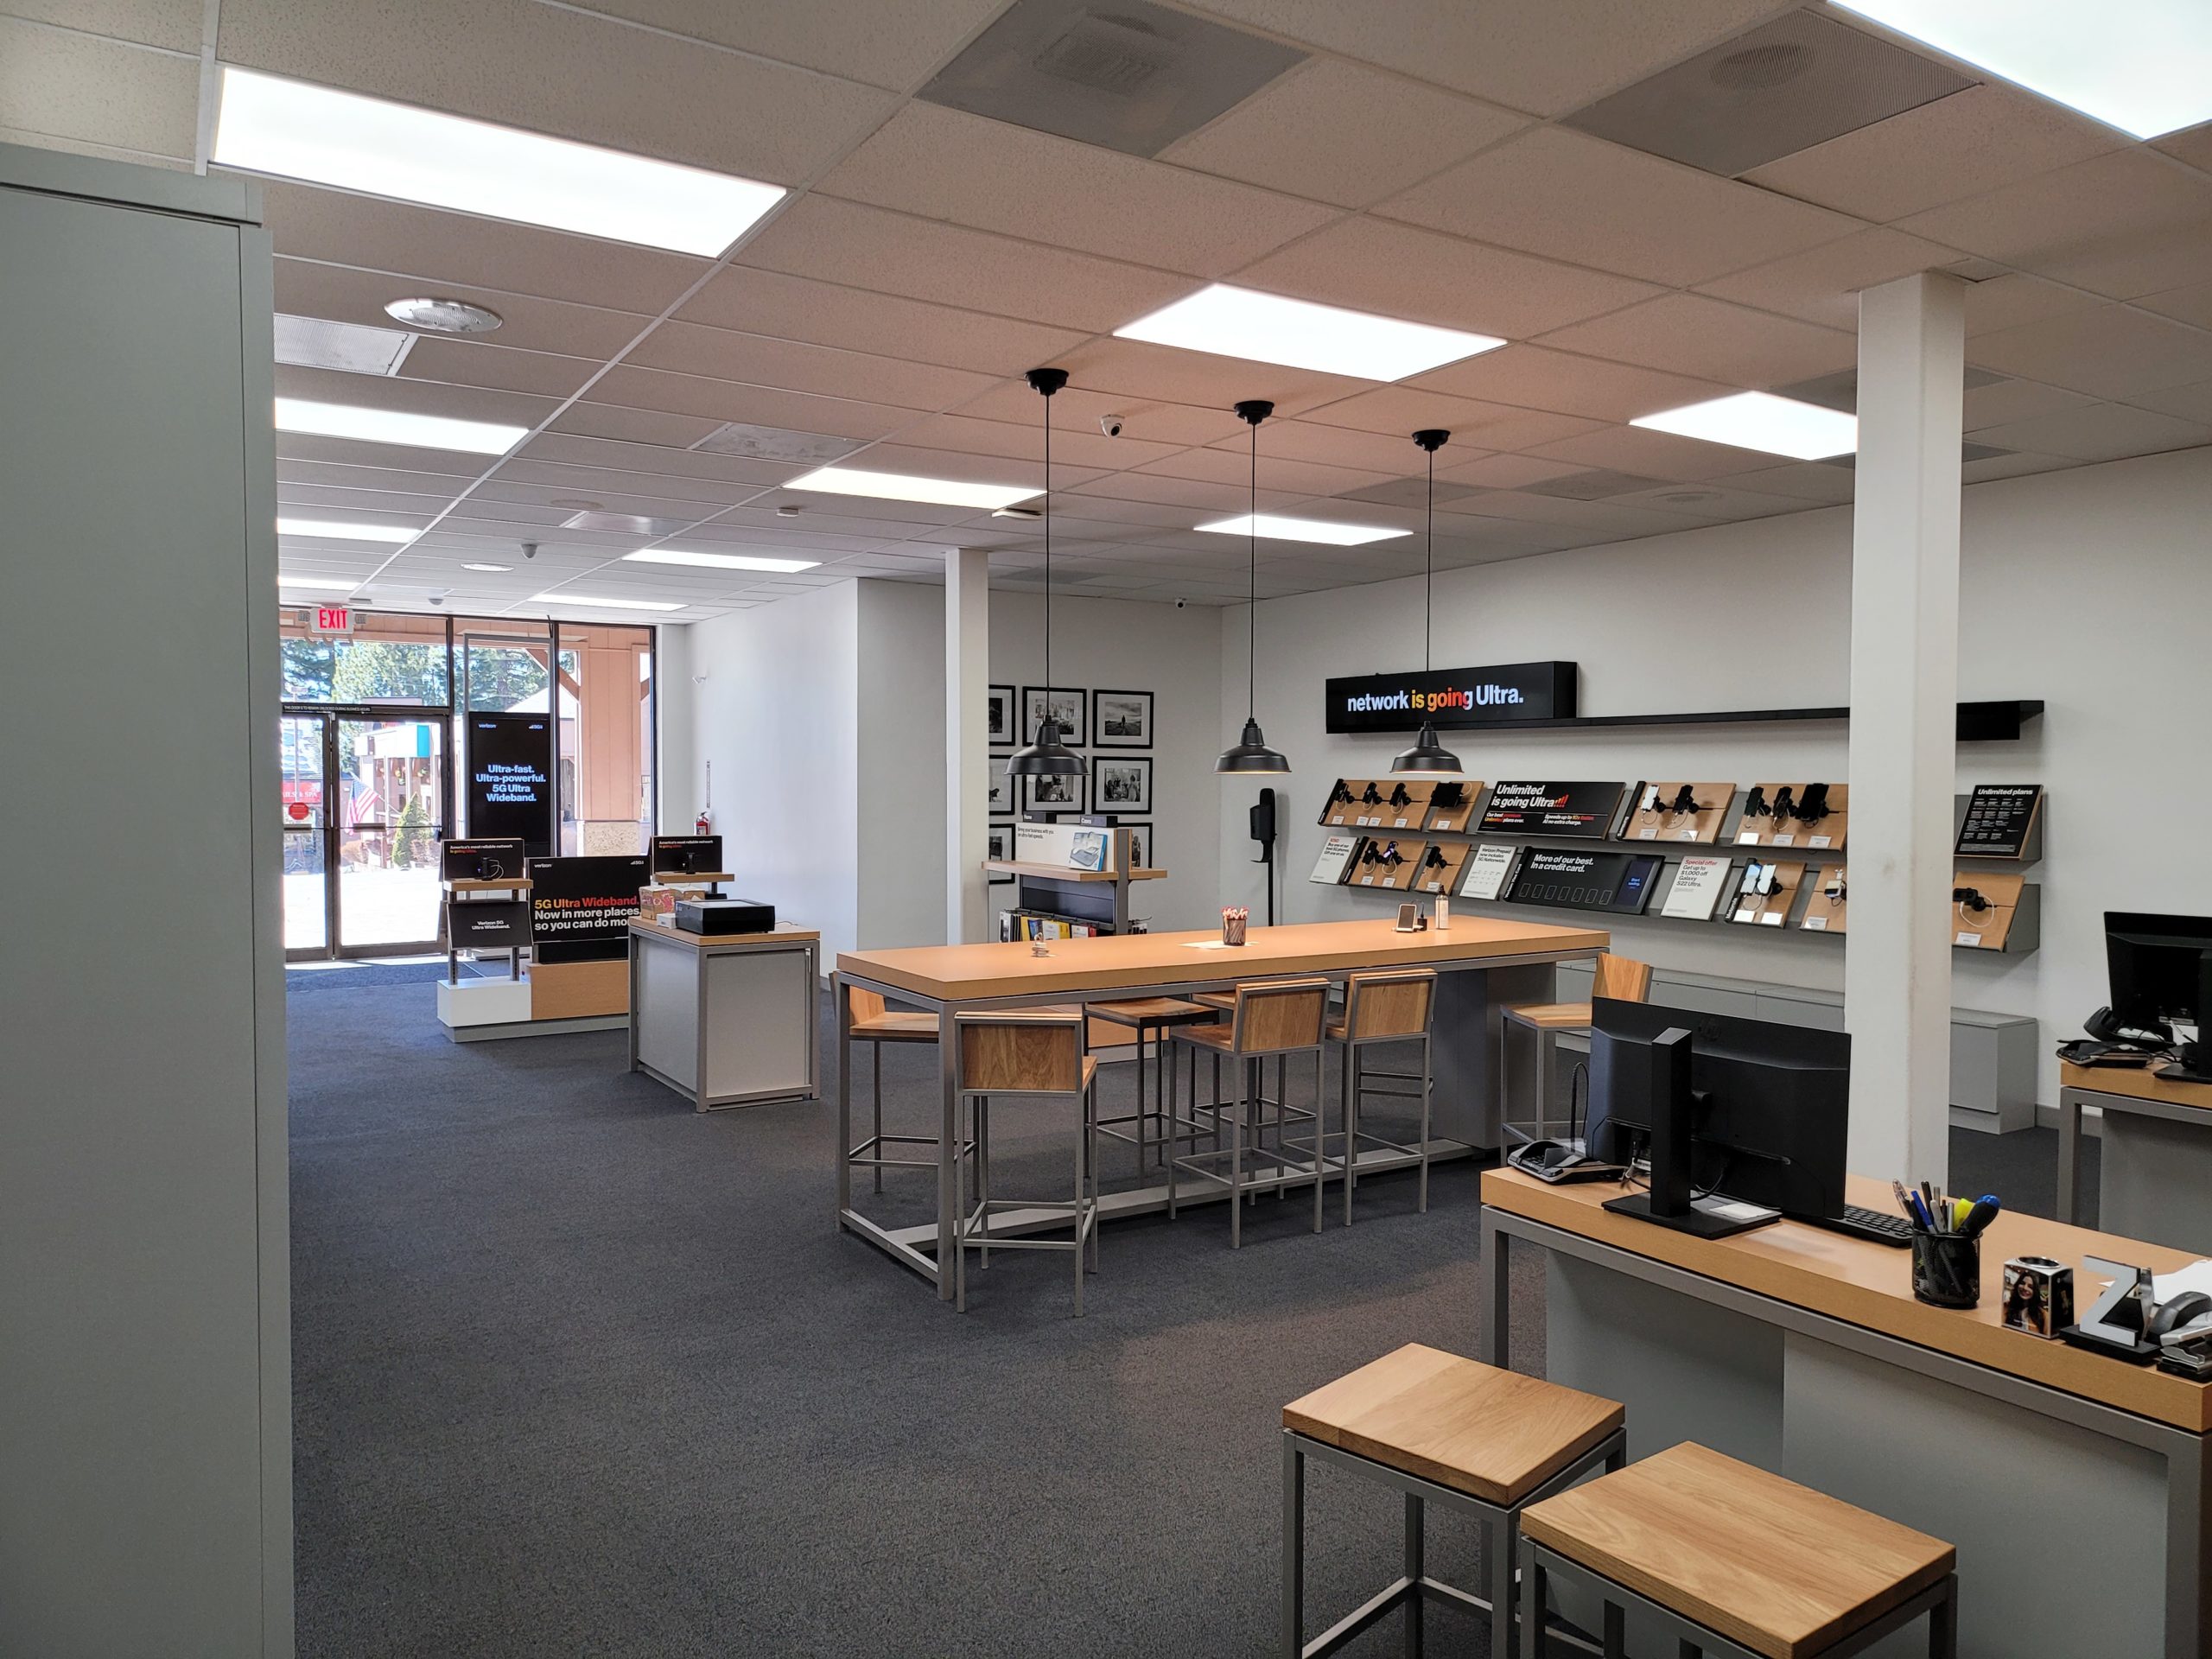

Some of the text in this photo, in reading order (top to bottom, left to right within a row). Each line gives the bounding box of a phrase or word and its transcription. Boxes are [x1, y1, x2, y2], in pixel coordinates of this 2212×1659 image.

[319, 609, 347, 630] EXIT
[1347, 683, 1524, 713] network is going Ultra.
[487, 765, 535, 773] Ultra-fast.
[476, 773, 547, 784] Ultra-powerful.
[492, 784, 531, 792] 5G Ultra
[1497, 784, 1546, 795] Unlimited
[486, 793, 537, 802] Wideband.
[1491, 796, 1554, 809] is going Ultra
[1530, 861, 1539, 869] In
[1533, 854, 1554, 862] More
[1574, 856, 1594, 866] best.
[1503, 882, 1514, 899] Verizon
[534, 899, 552, 909] 5G
[553, 899, 581, 908] Ultra
[582, 895, 639, 907] Wideband.
[534, 910, 561, 919] Now
[562, 908, 574, 918] in
[574, 909, 603, 918] more
[1725, 898, 1738, 919] Motorola
[534, 918, 629, 931] so you can do mo
